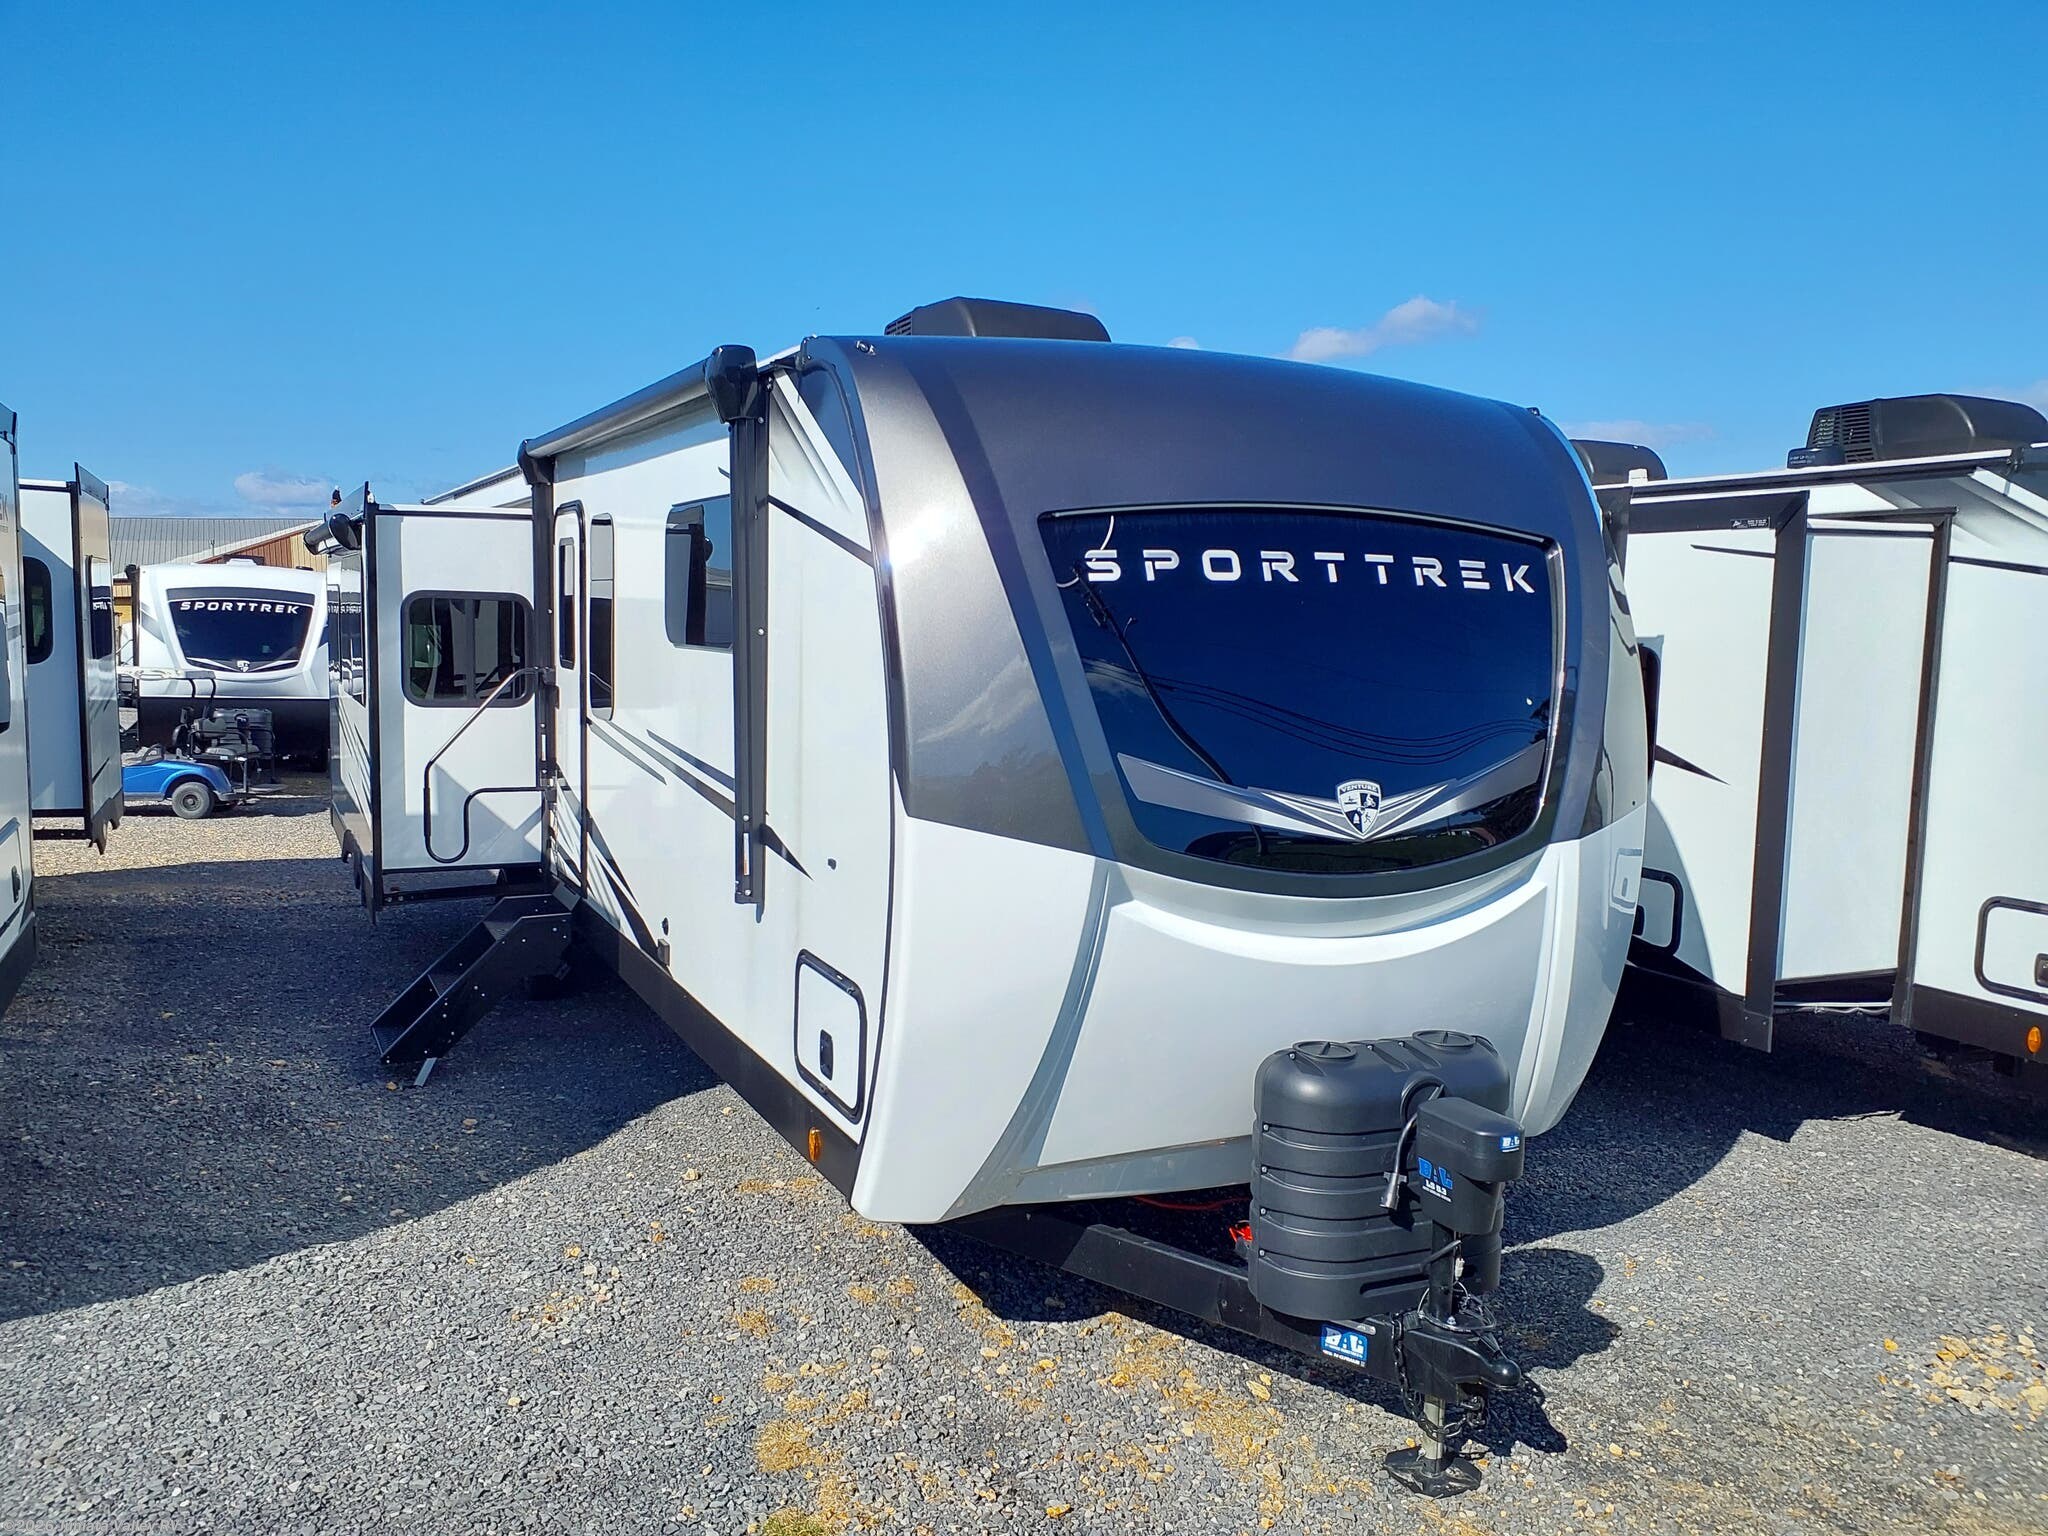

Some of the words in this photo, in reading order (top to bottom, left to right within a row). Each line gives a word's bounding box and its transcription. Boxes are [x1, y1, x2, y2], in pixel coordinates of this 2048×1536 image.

[1084, 549, 1535, 593] SPORTTREK
[180, 601, 300, 614] SPORTTREK
[1340, 784, 1378, 792] VENTURE
